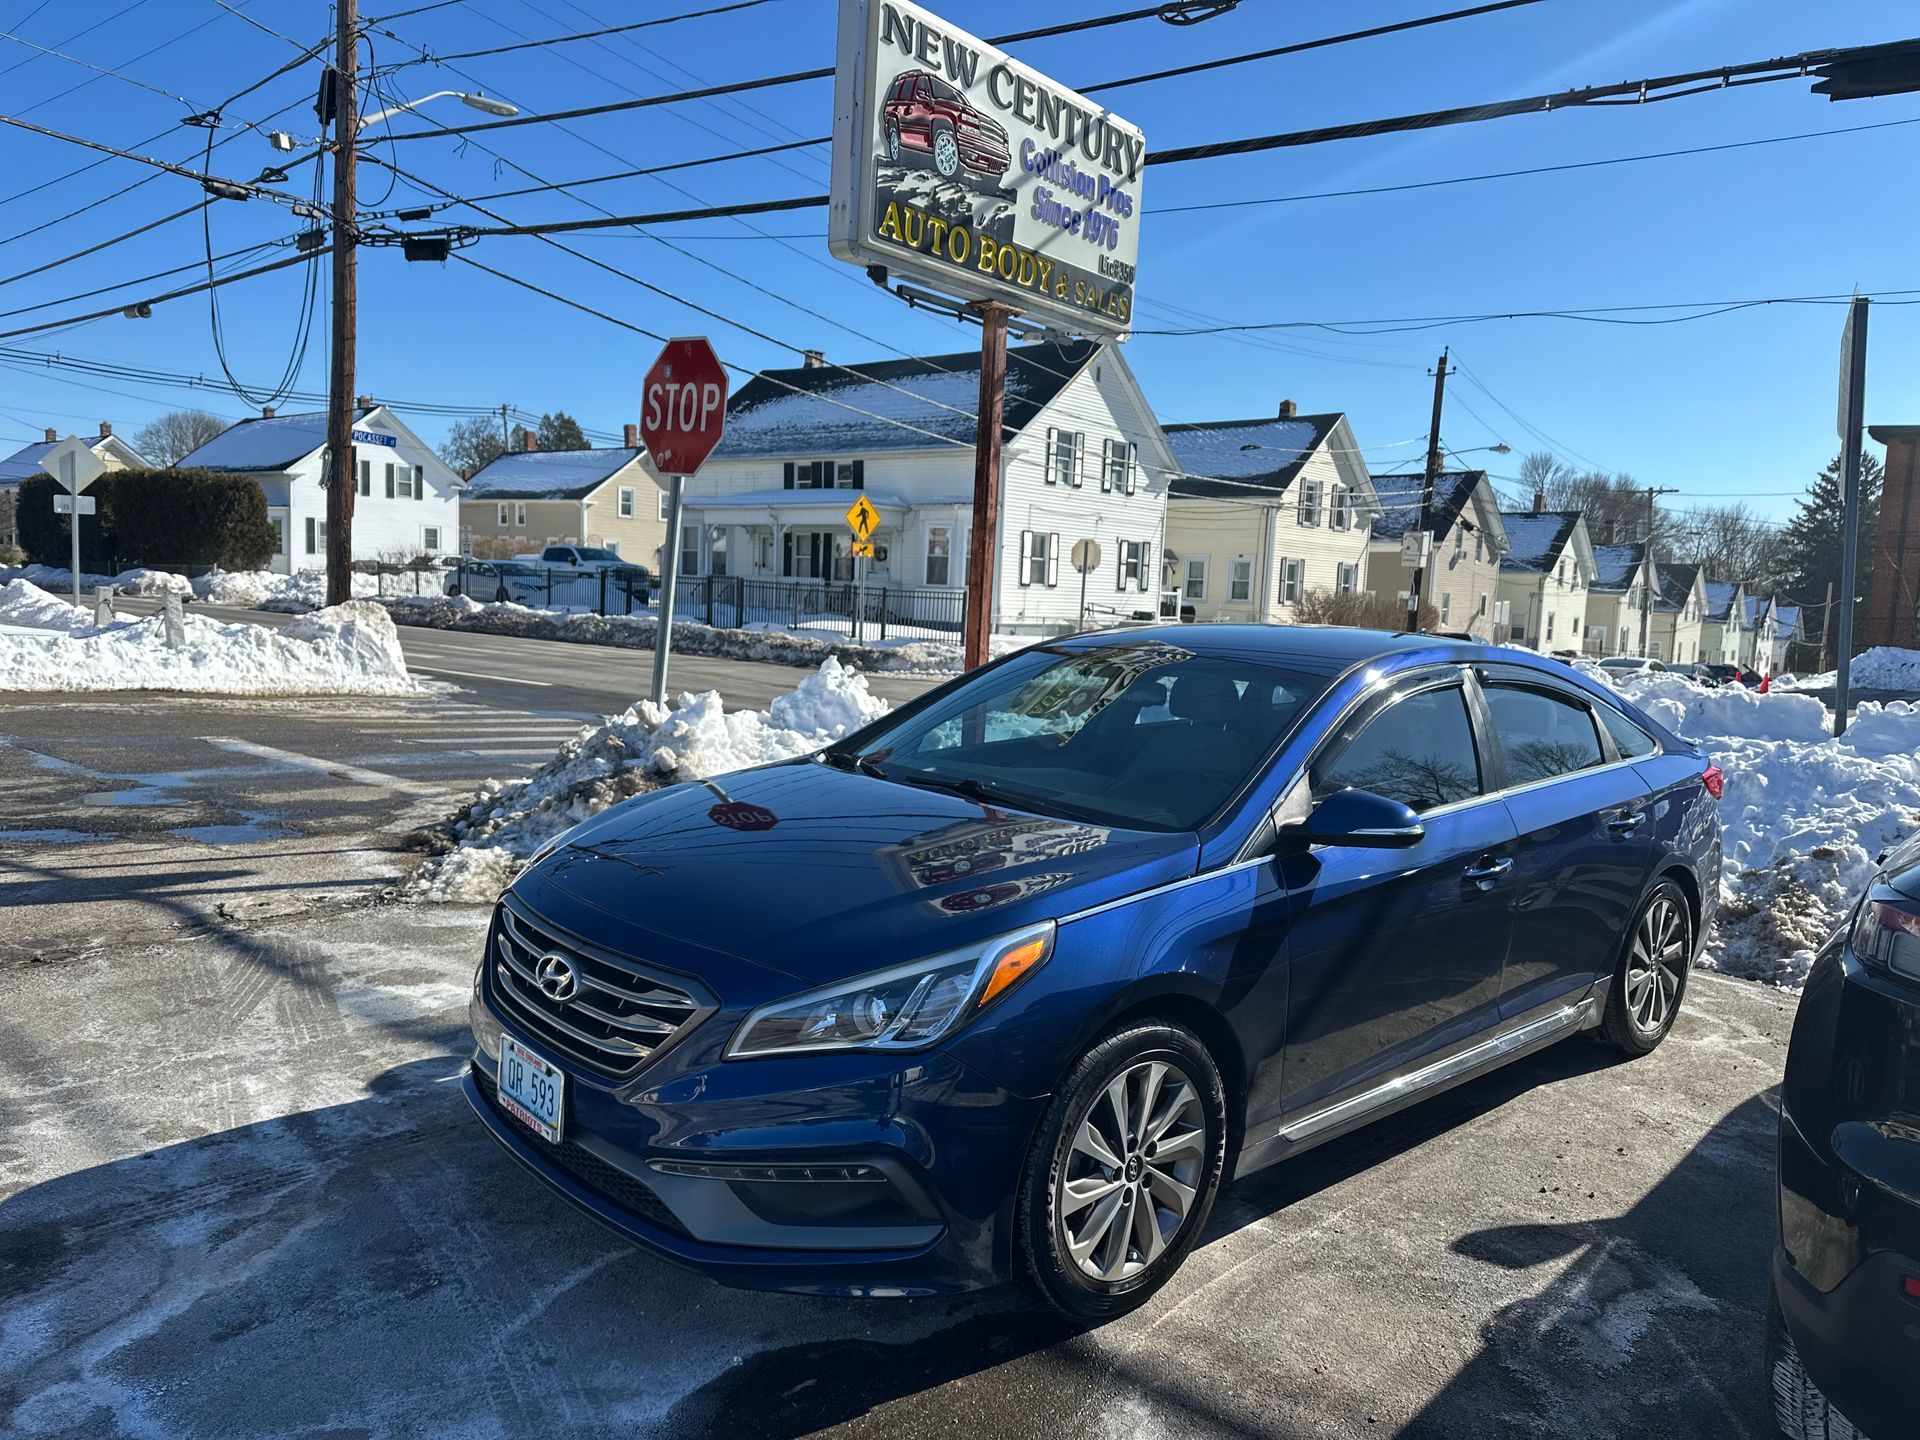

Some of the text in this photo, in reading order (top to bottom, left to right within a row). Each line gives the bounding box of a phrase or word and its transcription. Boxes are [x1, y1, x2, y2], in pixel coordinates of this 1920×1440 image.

[880, 3, 1144, 183] NEW CENTURY
[1020, 137, 1133, 218] Collision Pros
[1031, 186, 1120, 250] Since 1976
[880, 201, 1129, 321] AUTO BODY & SALES
[646, 382, 720, 432] STOP
[354, 431, 387, 445] POCASSET
[506, 1100, 543, 1134] PATRIOTS
[531, 1072, 554, 1117] 593
